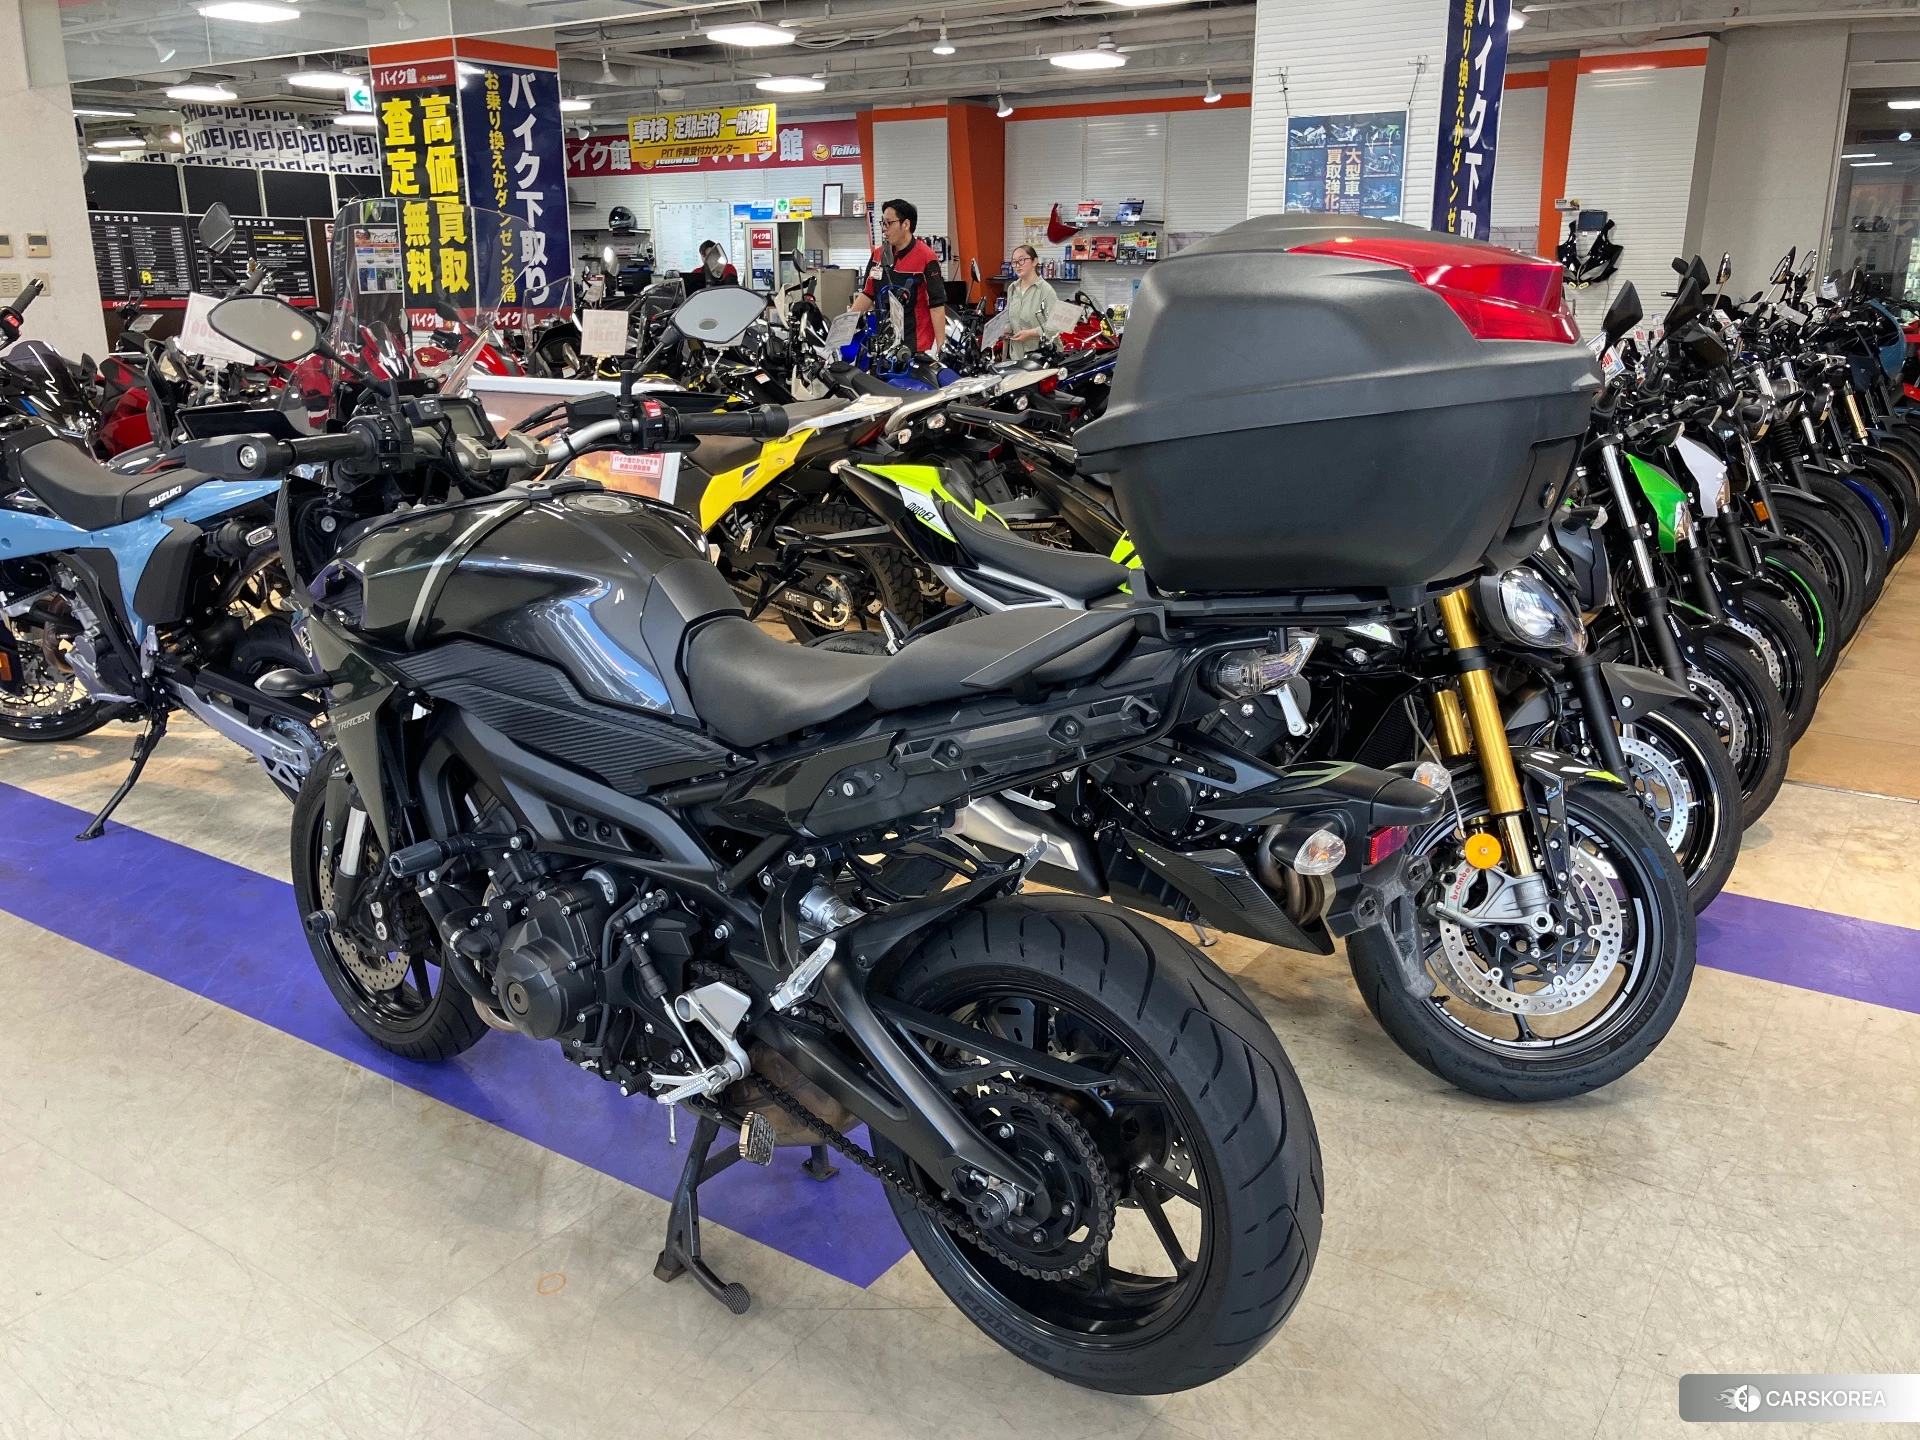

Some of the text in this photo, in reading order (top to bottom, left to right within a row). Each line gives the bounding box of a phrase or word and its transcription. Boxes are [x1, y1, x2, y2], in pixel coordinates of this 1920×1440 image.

[380, 68, 417, 86] バイク館
[185, 127, 227, 154] SHOEI
[660, 144, 741, 158] PIT 作業受付カウンター
[484, 70, 517, 303] お乗り換えがダンゼンお得
[508, 72, 550, 306] バイク下取り
[1324, 148, 1343, 213] 買取強化
[1344, 147, 1362, 197] 大型車
[381, 97, 434, 295] 査定無料
[420, 94, 470, 294] 高価買取
[148, 484, 183, 508] SUZUKI
[336, 710, 371, 731] TRACER
[1450, 867, 1472, 900] brembo
